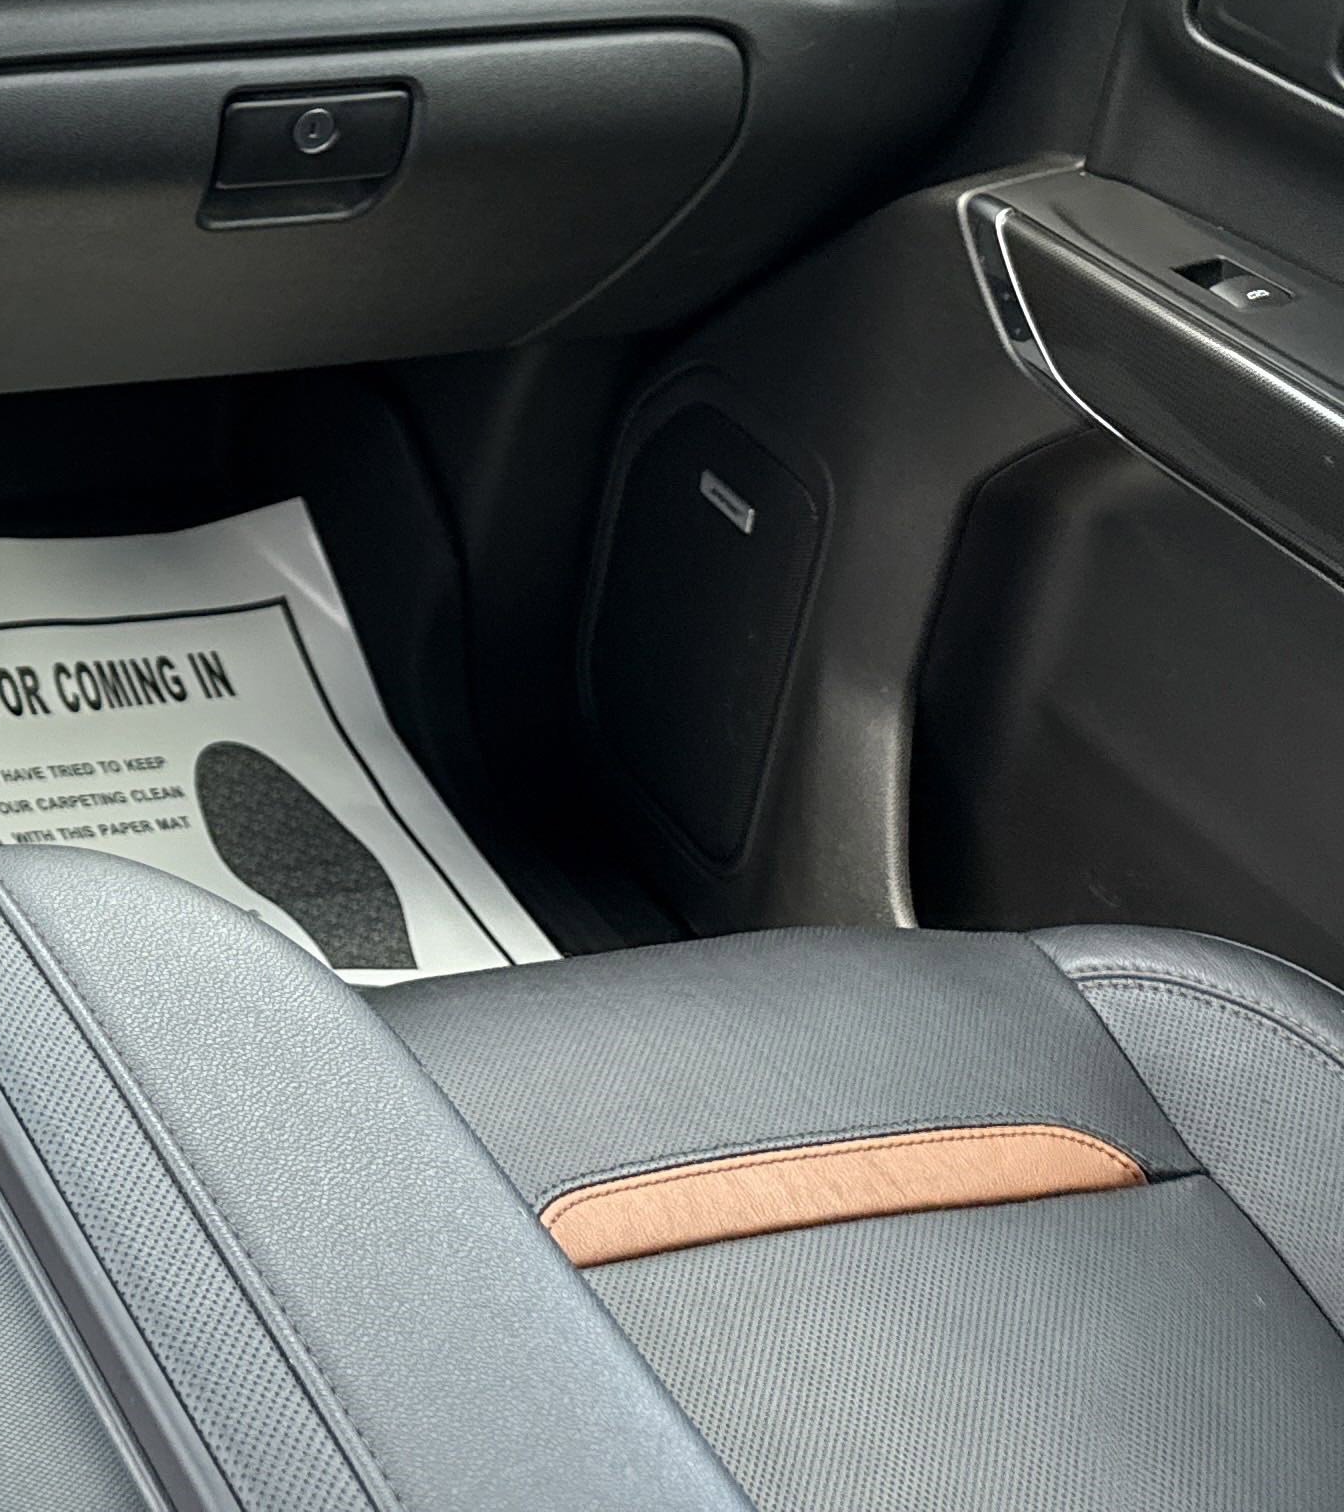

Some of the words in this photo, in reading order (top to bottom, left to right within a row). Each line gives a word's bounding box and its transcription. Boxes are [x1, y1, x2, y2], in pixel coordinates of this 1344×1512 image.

[52, 655, 187, 714] COMING
[187, 650, 237, 699] IN
[0, 765, 47, 783] HAVE
[47, 761, 97, 779] TRIED
[96, 759, 122, 775] TO
[123, 755, 168, 772] KEEP
[35, 791, 128, 811] CARPETING
[130, 785, 186, 803] CLEAN
[11, 828, 56, 844] WITH
[58, 824, 96, 840] THIS
[97, 819, 154, 837] PAPER
[155, 815, 192, 831] MAT
